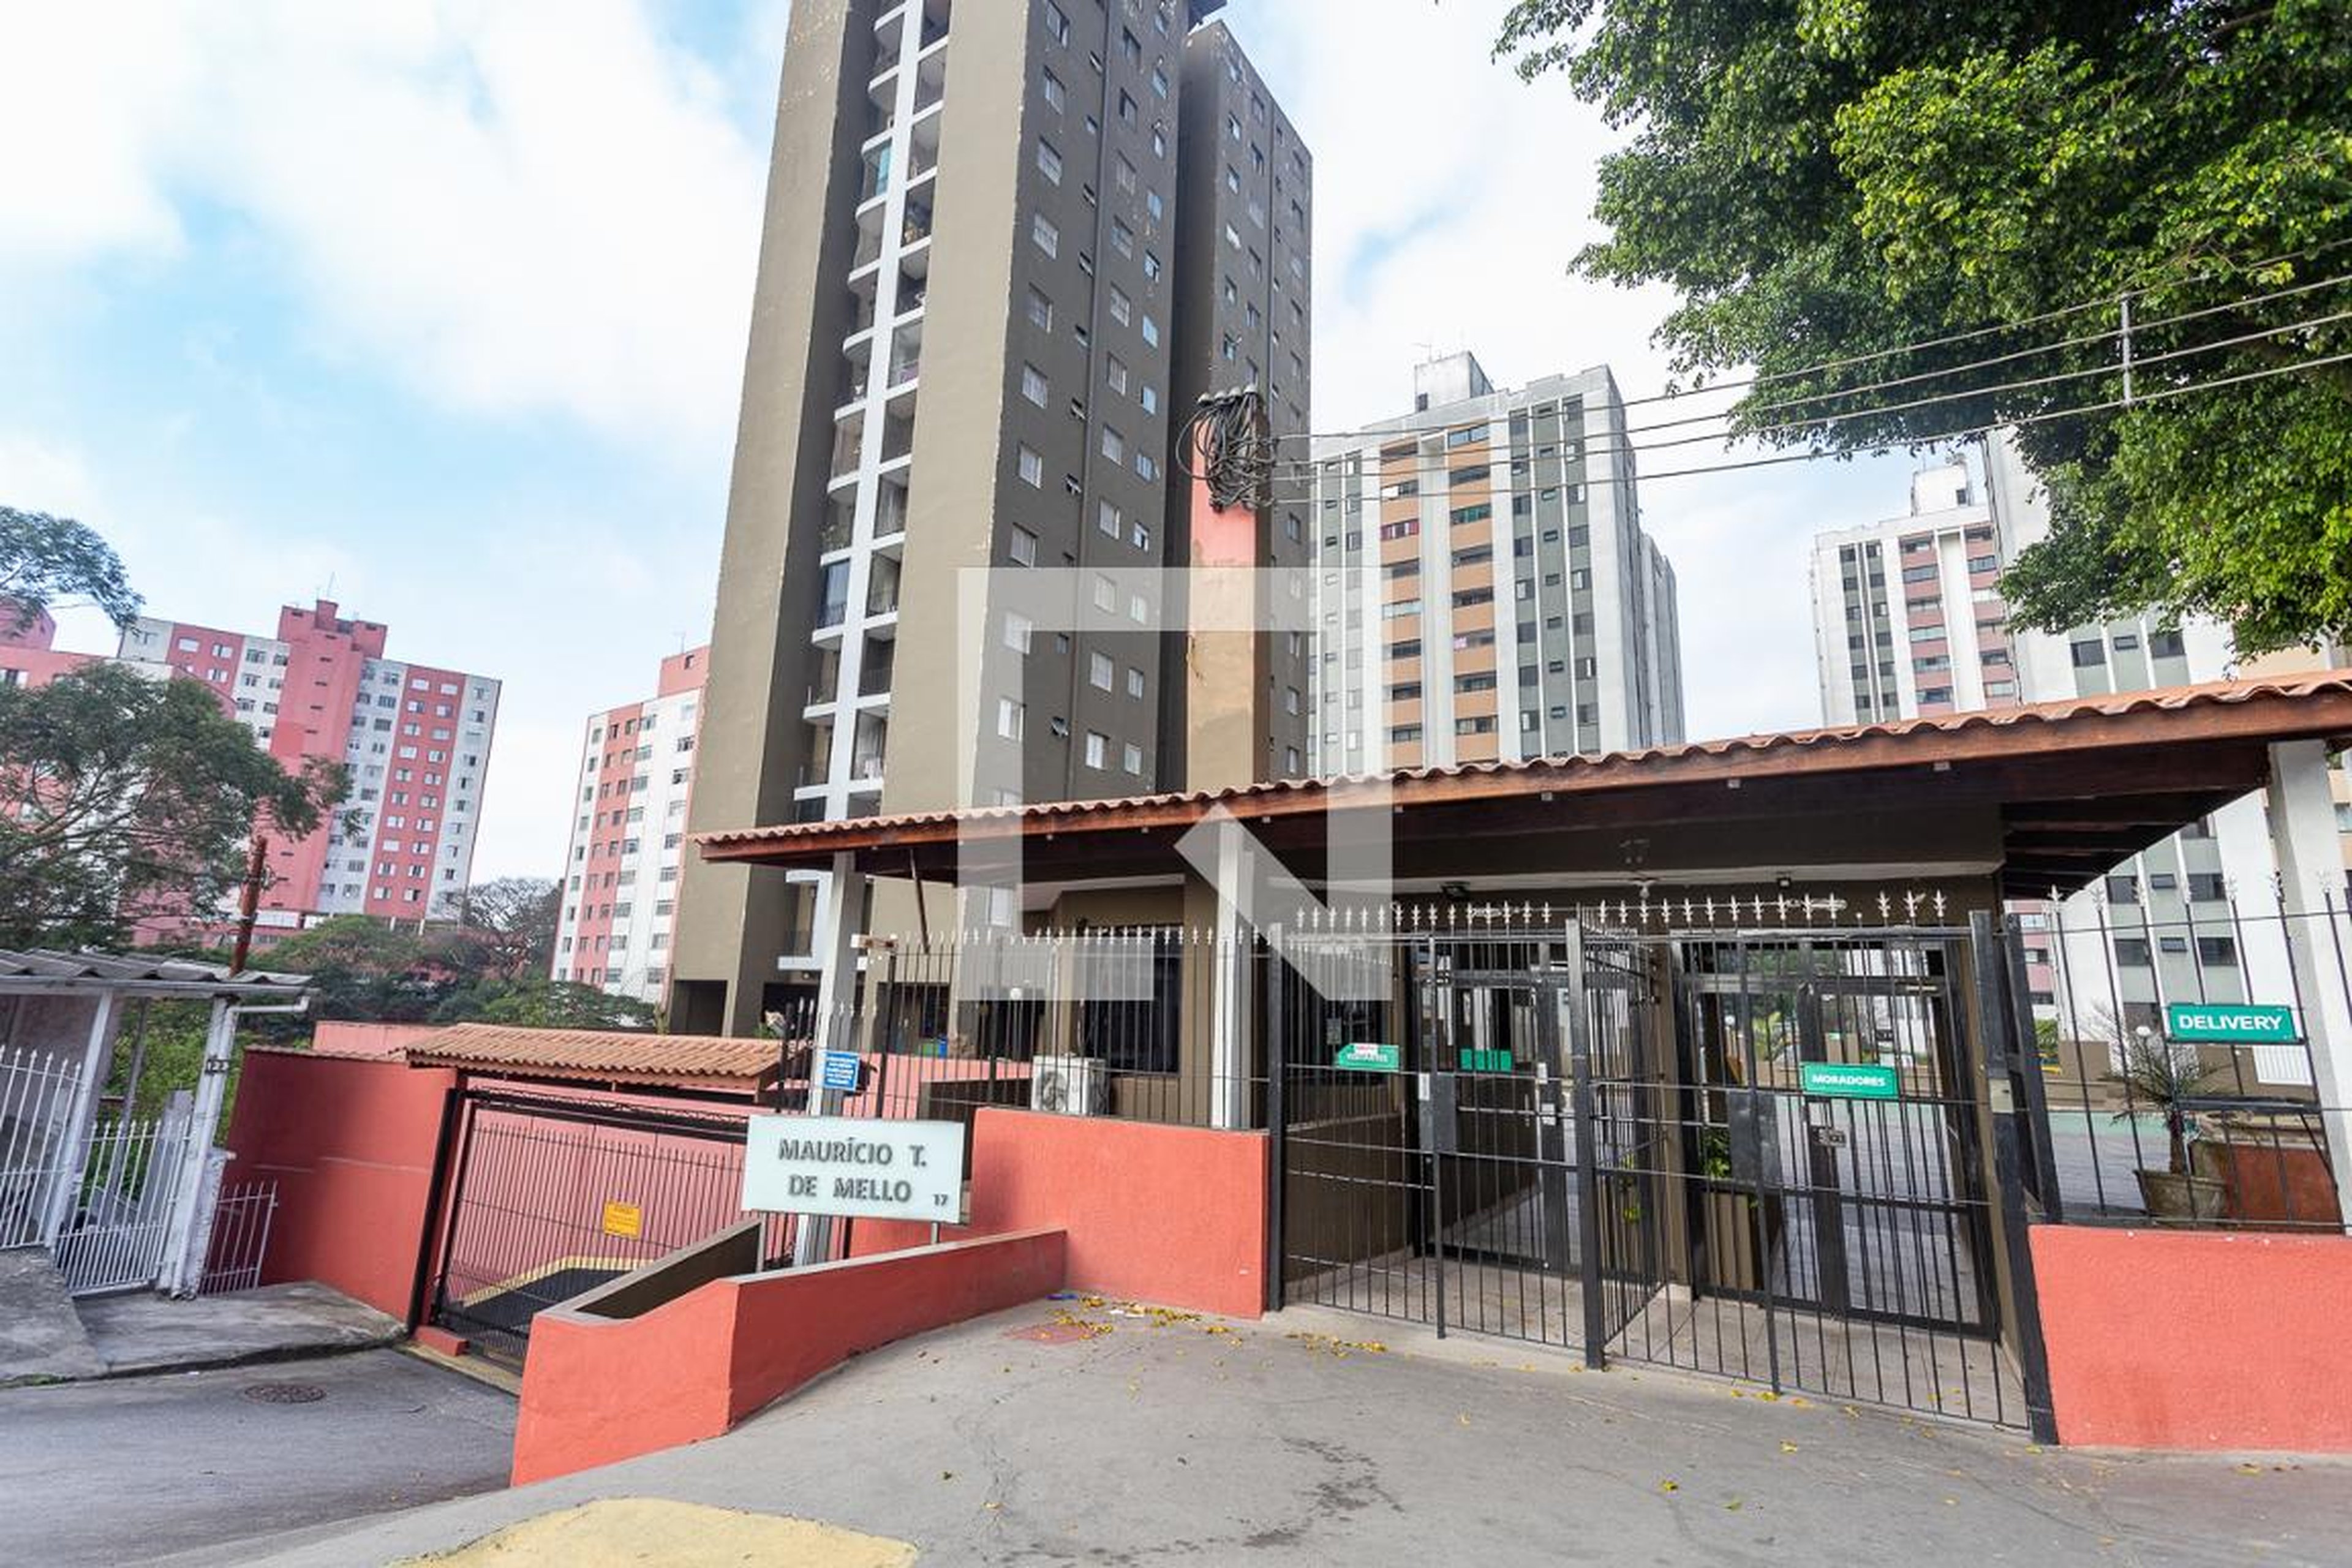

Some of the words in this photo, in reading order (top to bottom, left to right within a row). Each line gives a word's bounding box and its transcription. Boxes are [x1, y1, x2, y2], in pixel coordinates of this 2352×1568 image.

[2178, 1014, 2283, 1030] DELIVERY
[1811, 1074, 1886, 1087] MORADORES
[778, 1136, 893, 1166] MAURÍCIO
[908, 1144, 927, 1167] T.
[788, 1174, 818, 1197] DE
[832, 1177, 913, 1203] MELLO
